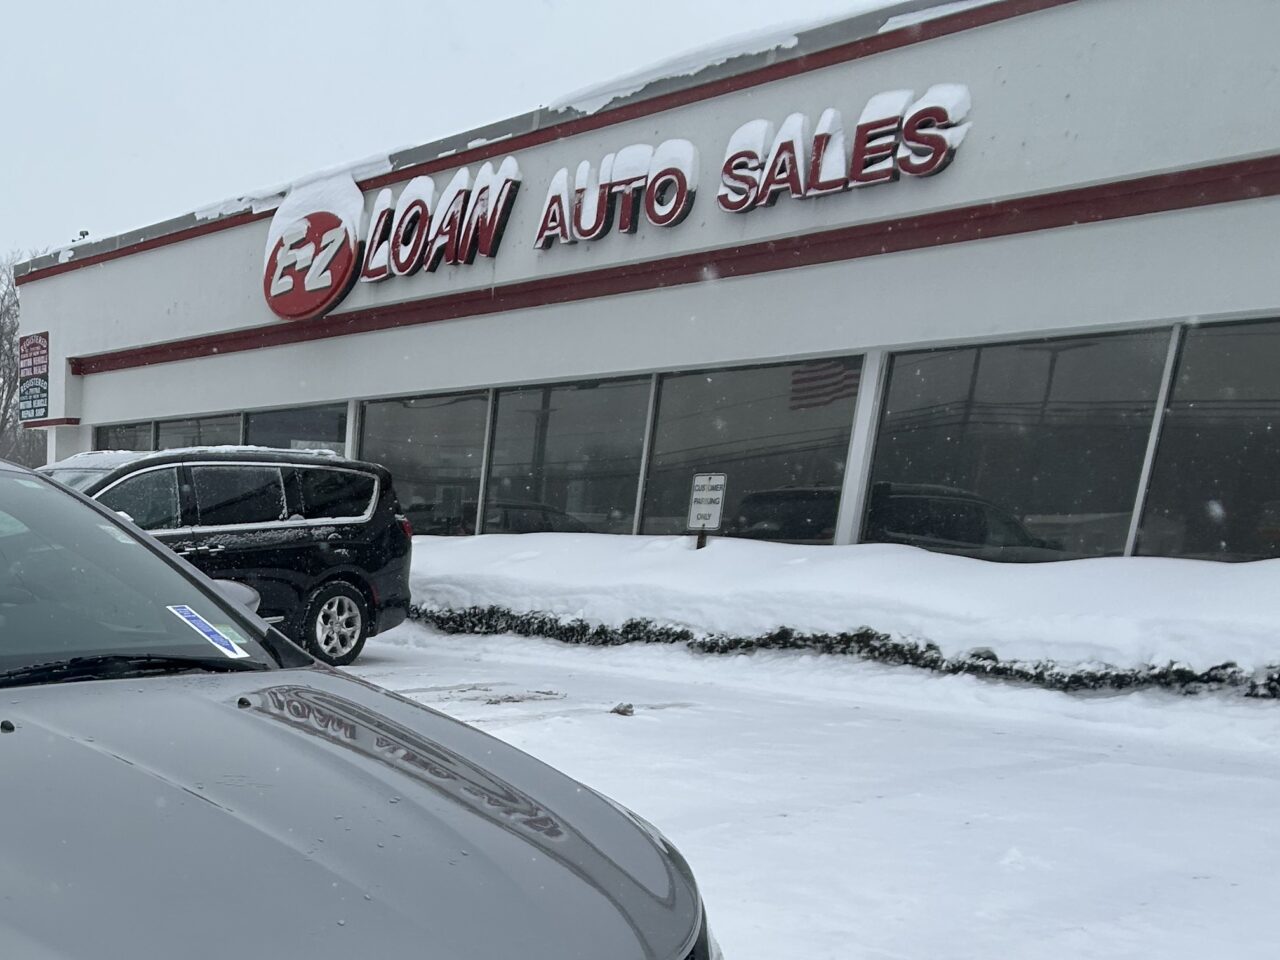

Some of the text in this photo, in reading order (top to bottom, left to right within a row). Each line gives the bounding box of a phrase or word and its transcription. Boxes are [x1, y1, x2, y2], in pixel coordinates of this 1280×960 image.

[360, 178, 520, 283] LOAN
[534, 166, 696, 250] AUTO
[717, 106, 956, 213] SALES
[20, 377, 47, 394] REGISTERED
[35, 407, 46, 417] SHOP
[694, 484, 724, 492] CUSTOMER
[693, 497, 721, 505] PARKING
[697, 512, 712, 521] ONLY
